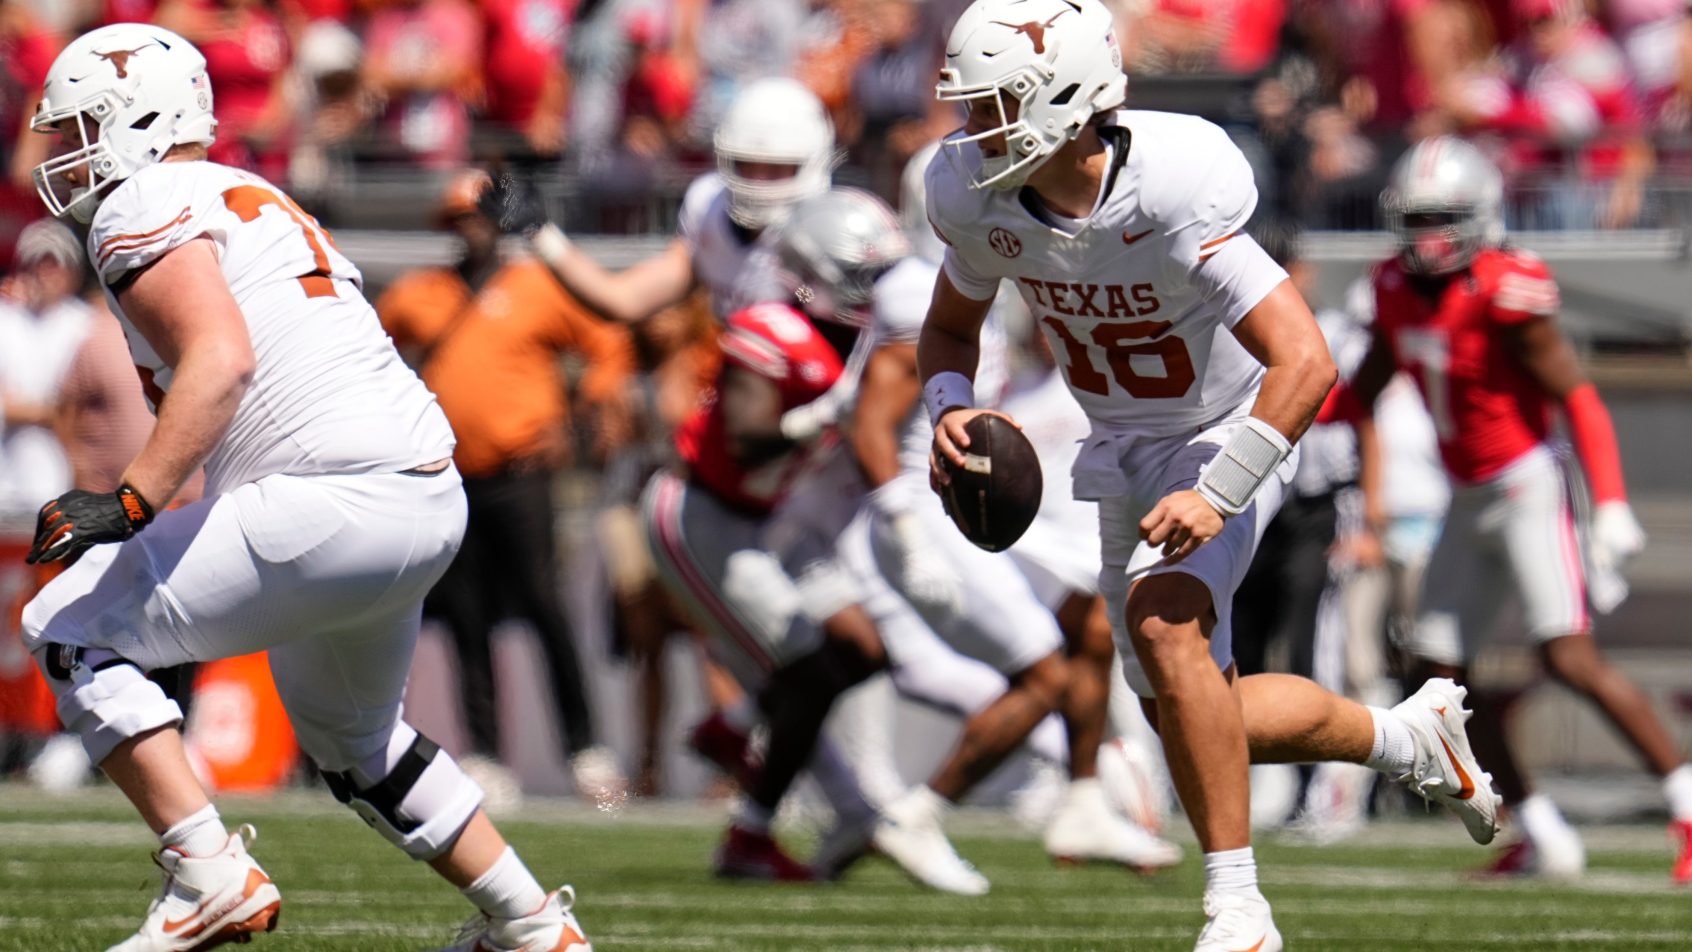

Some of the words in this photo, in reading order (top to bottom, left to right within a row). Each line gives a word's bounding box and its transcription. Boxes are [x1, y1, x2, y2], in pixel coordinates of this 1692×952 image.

[1018, 276, 1161, 318] TEXAS
[1041, 314, 1196, 400] 16
[121, 494, 145, 521] NIKE
